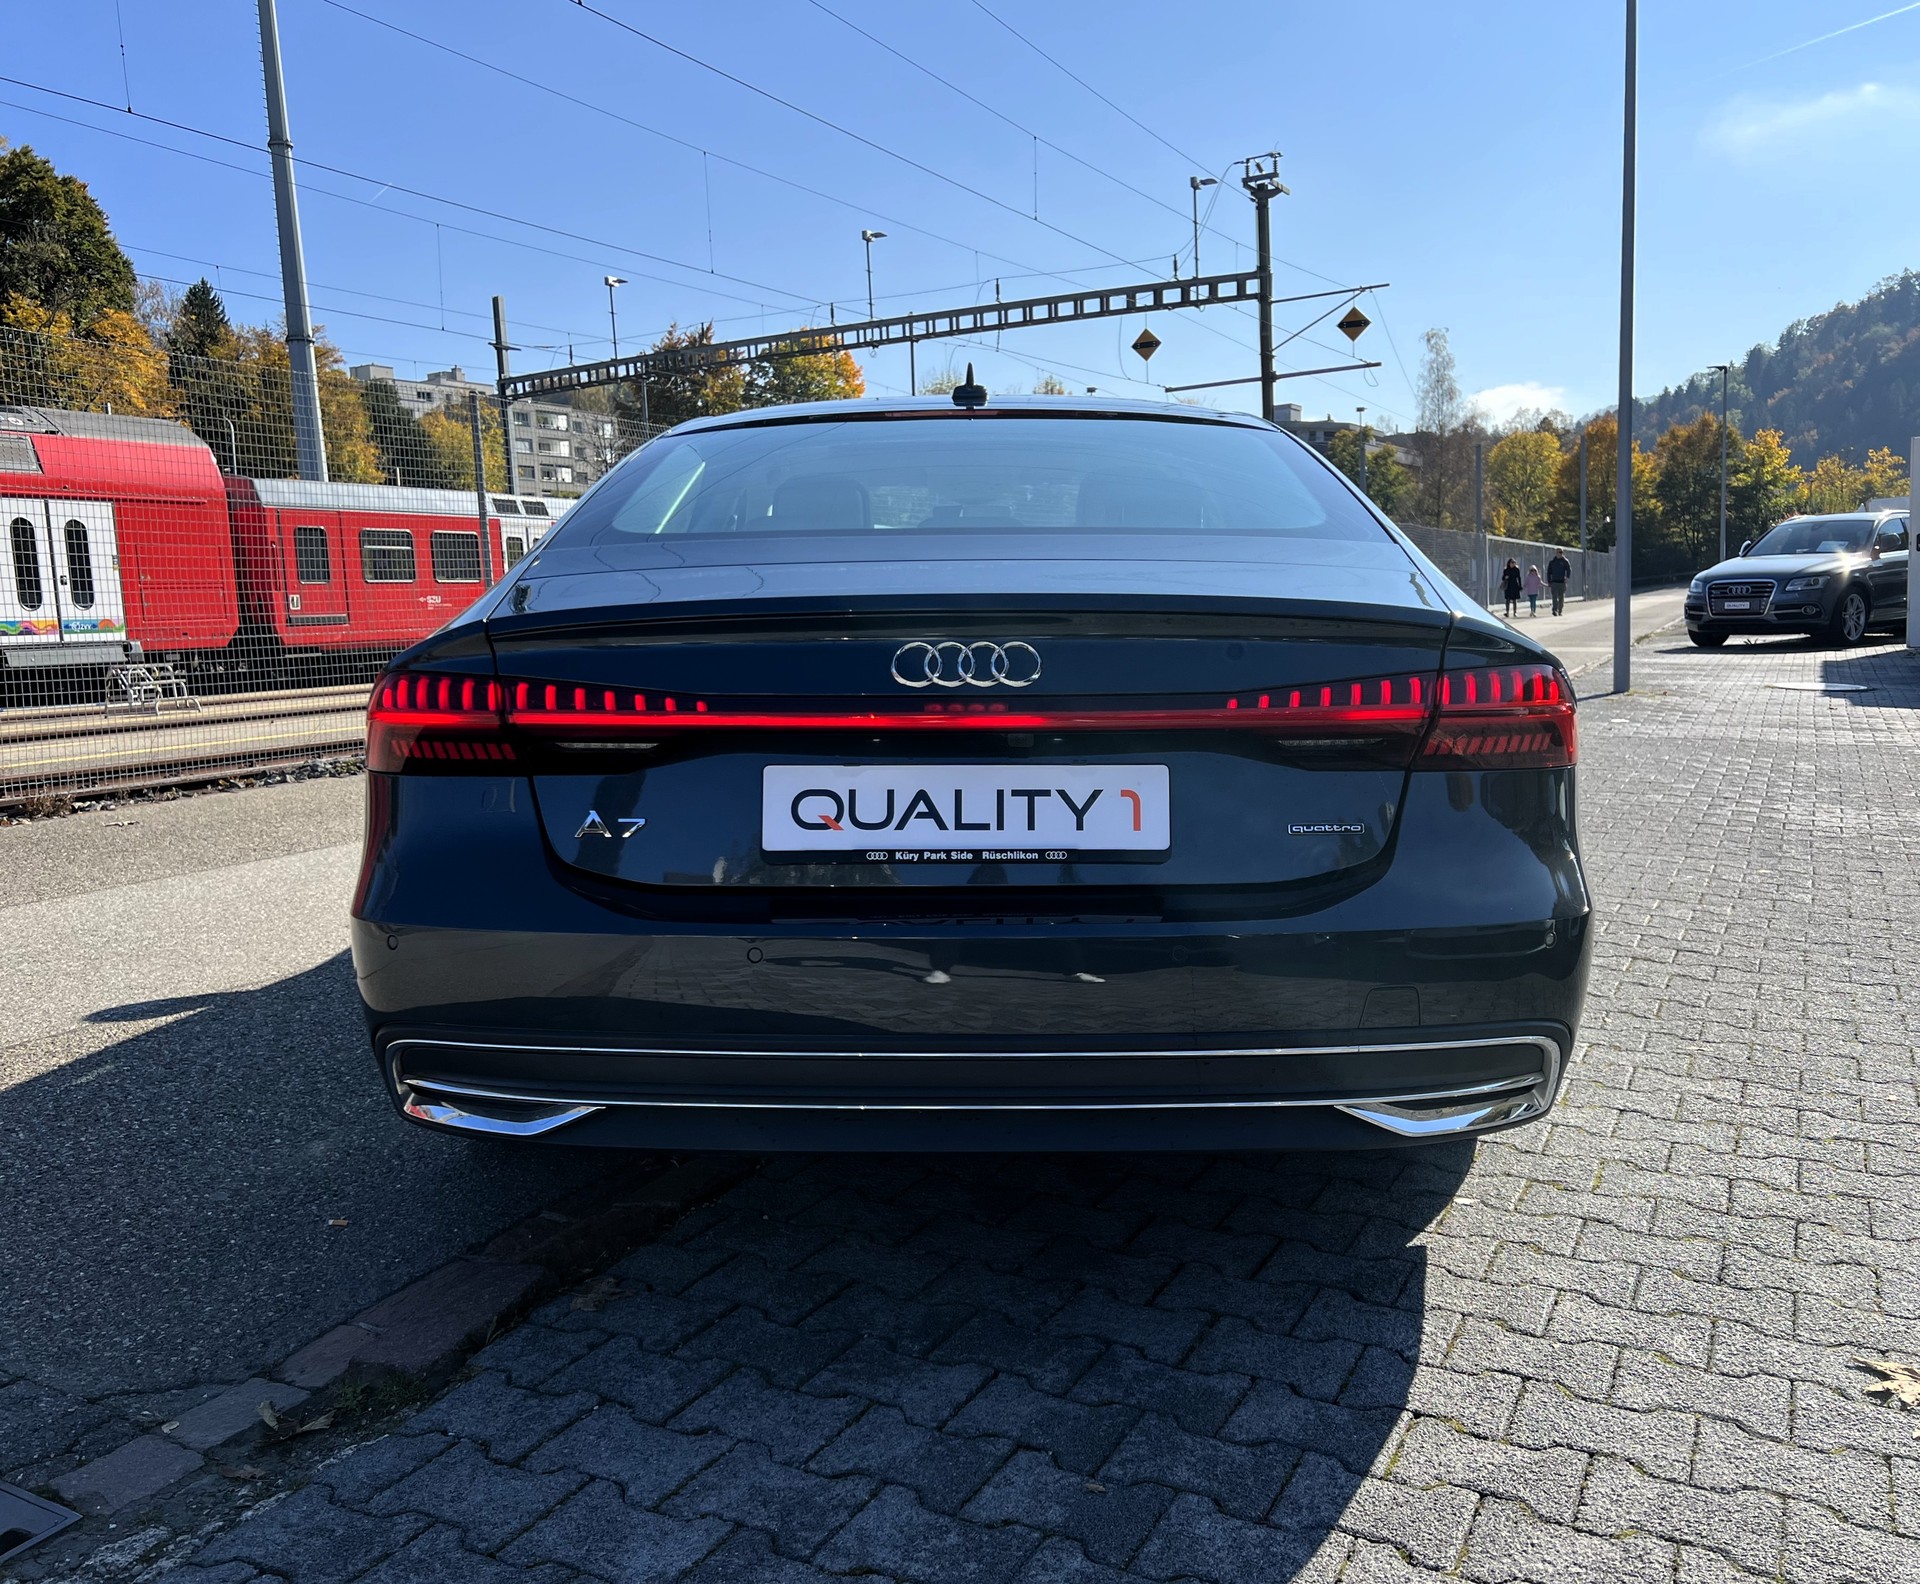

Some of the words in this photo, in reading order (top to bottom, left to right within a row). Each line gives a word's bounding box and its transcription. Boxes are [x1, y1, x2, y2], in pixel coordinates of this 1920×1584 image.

[574, 809, 646, 838] A7
[1292, 824, 1361, 833] quattro
[895, 850, 919, 862] Küry
[923, 850, 947, 860] Park
[950, 850, 974, 860] Side
[981, 850, 1039, 860] Rüschlikon
